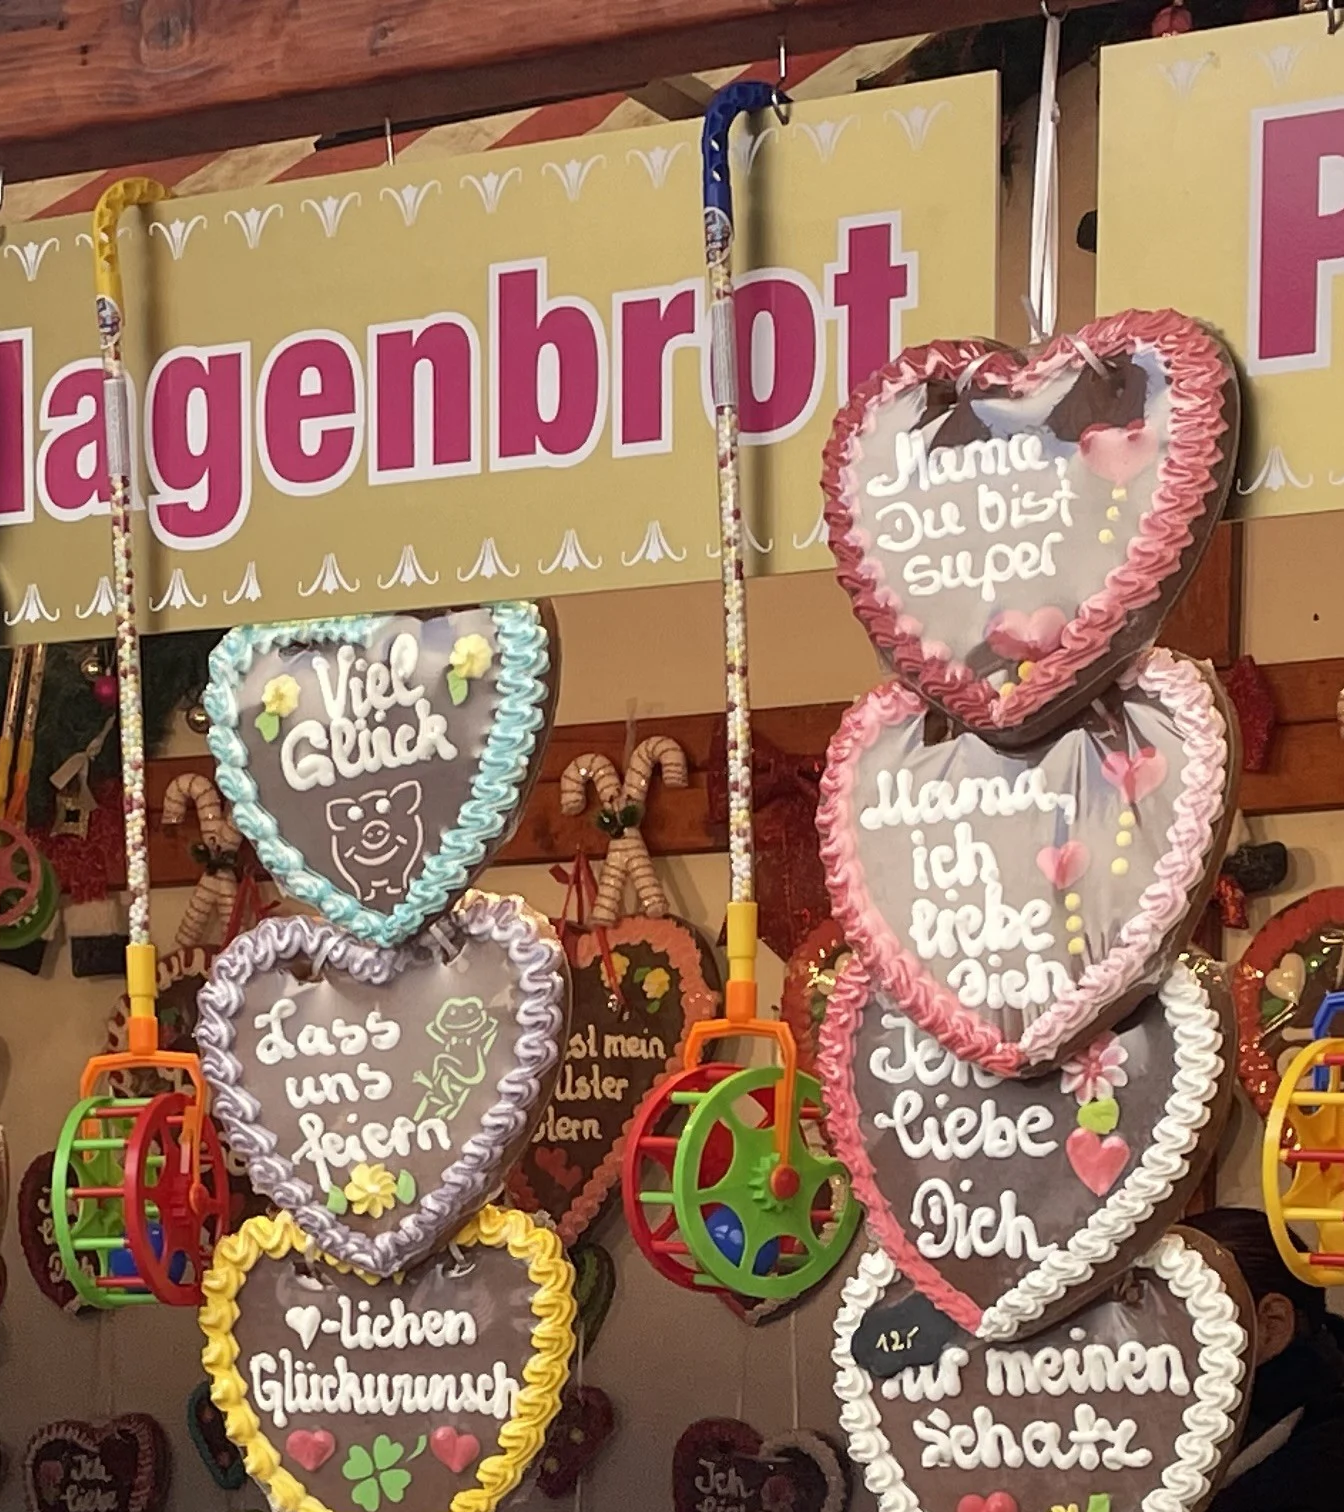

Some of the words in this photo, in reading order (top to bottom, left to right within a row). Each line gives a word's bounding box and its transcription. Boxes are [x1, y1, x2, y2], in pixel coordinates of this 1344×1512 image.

[866, 431, 1068, 498] Mama,
[876, 500, 967, 552] Du
[977, 479, 1080, 534] bist
[902, 531, 1065, 602] super
[312, 633, 425, 720] Viel
[281, 698, 458, 791] Glück
[859, 765, 1077, 830] Mama,
[910, 821, 1001, 890] ich
[947, 952, 1078, 1011] Dich
[255, 997, 402, 1065] Lass
[603, 1027, 667, 1060] mein
[284, 1062, 394, 1108] uns
[292, 1112, 455, 1192] feiern
[873, 1089, 1059, 1161] liebe
[910, 1177, 1058, 1262] Dich
[249, 1348, 522, 1428] Glückwunsch
[985, 1327, 1190, 1396] meinen
[913, 1403, 1153, 1471] Schatz
[695, 1457, 754, 1500] Ich
